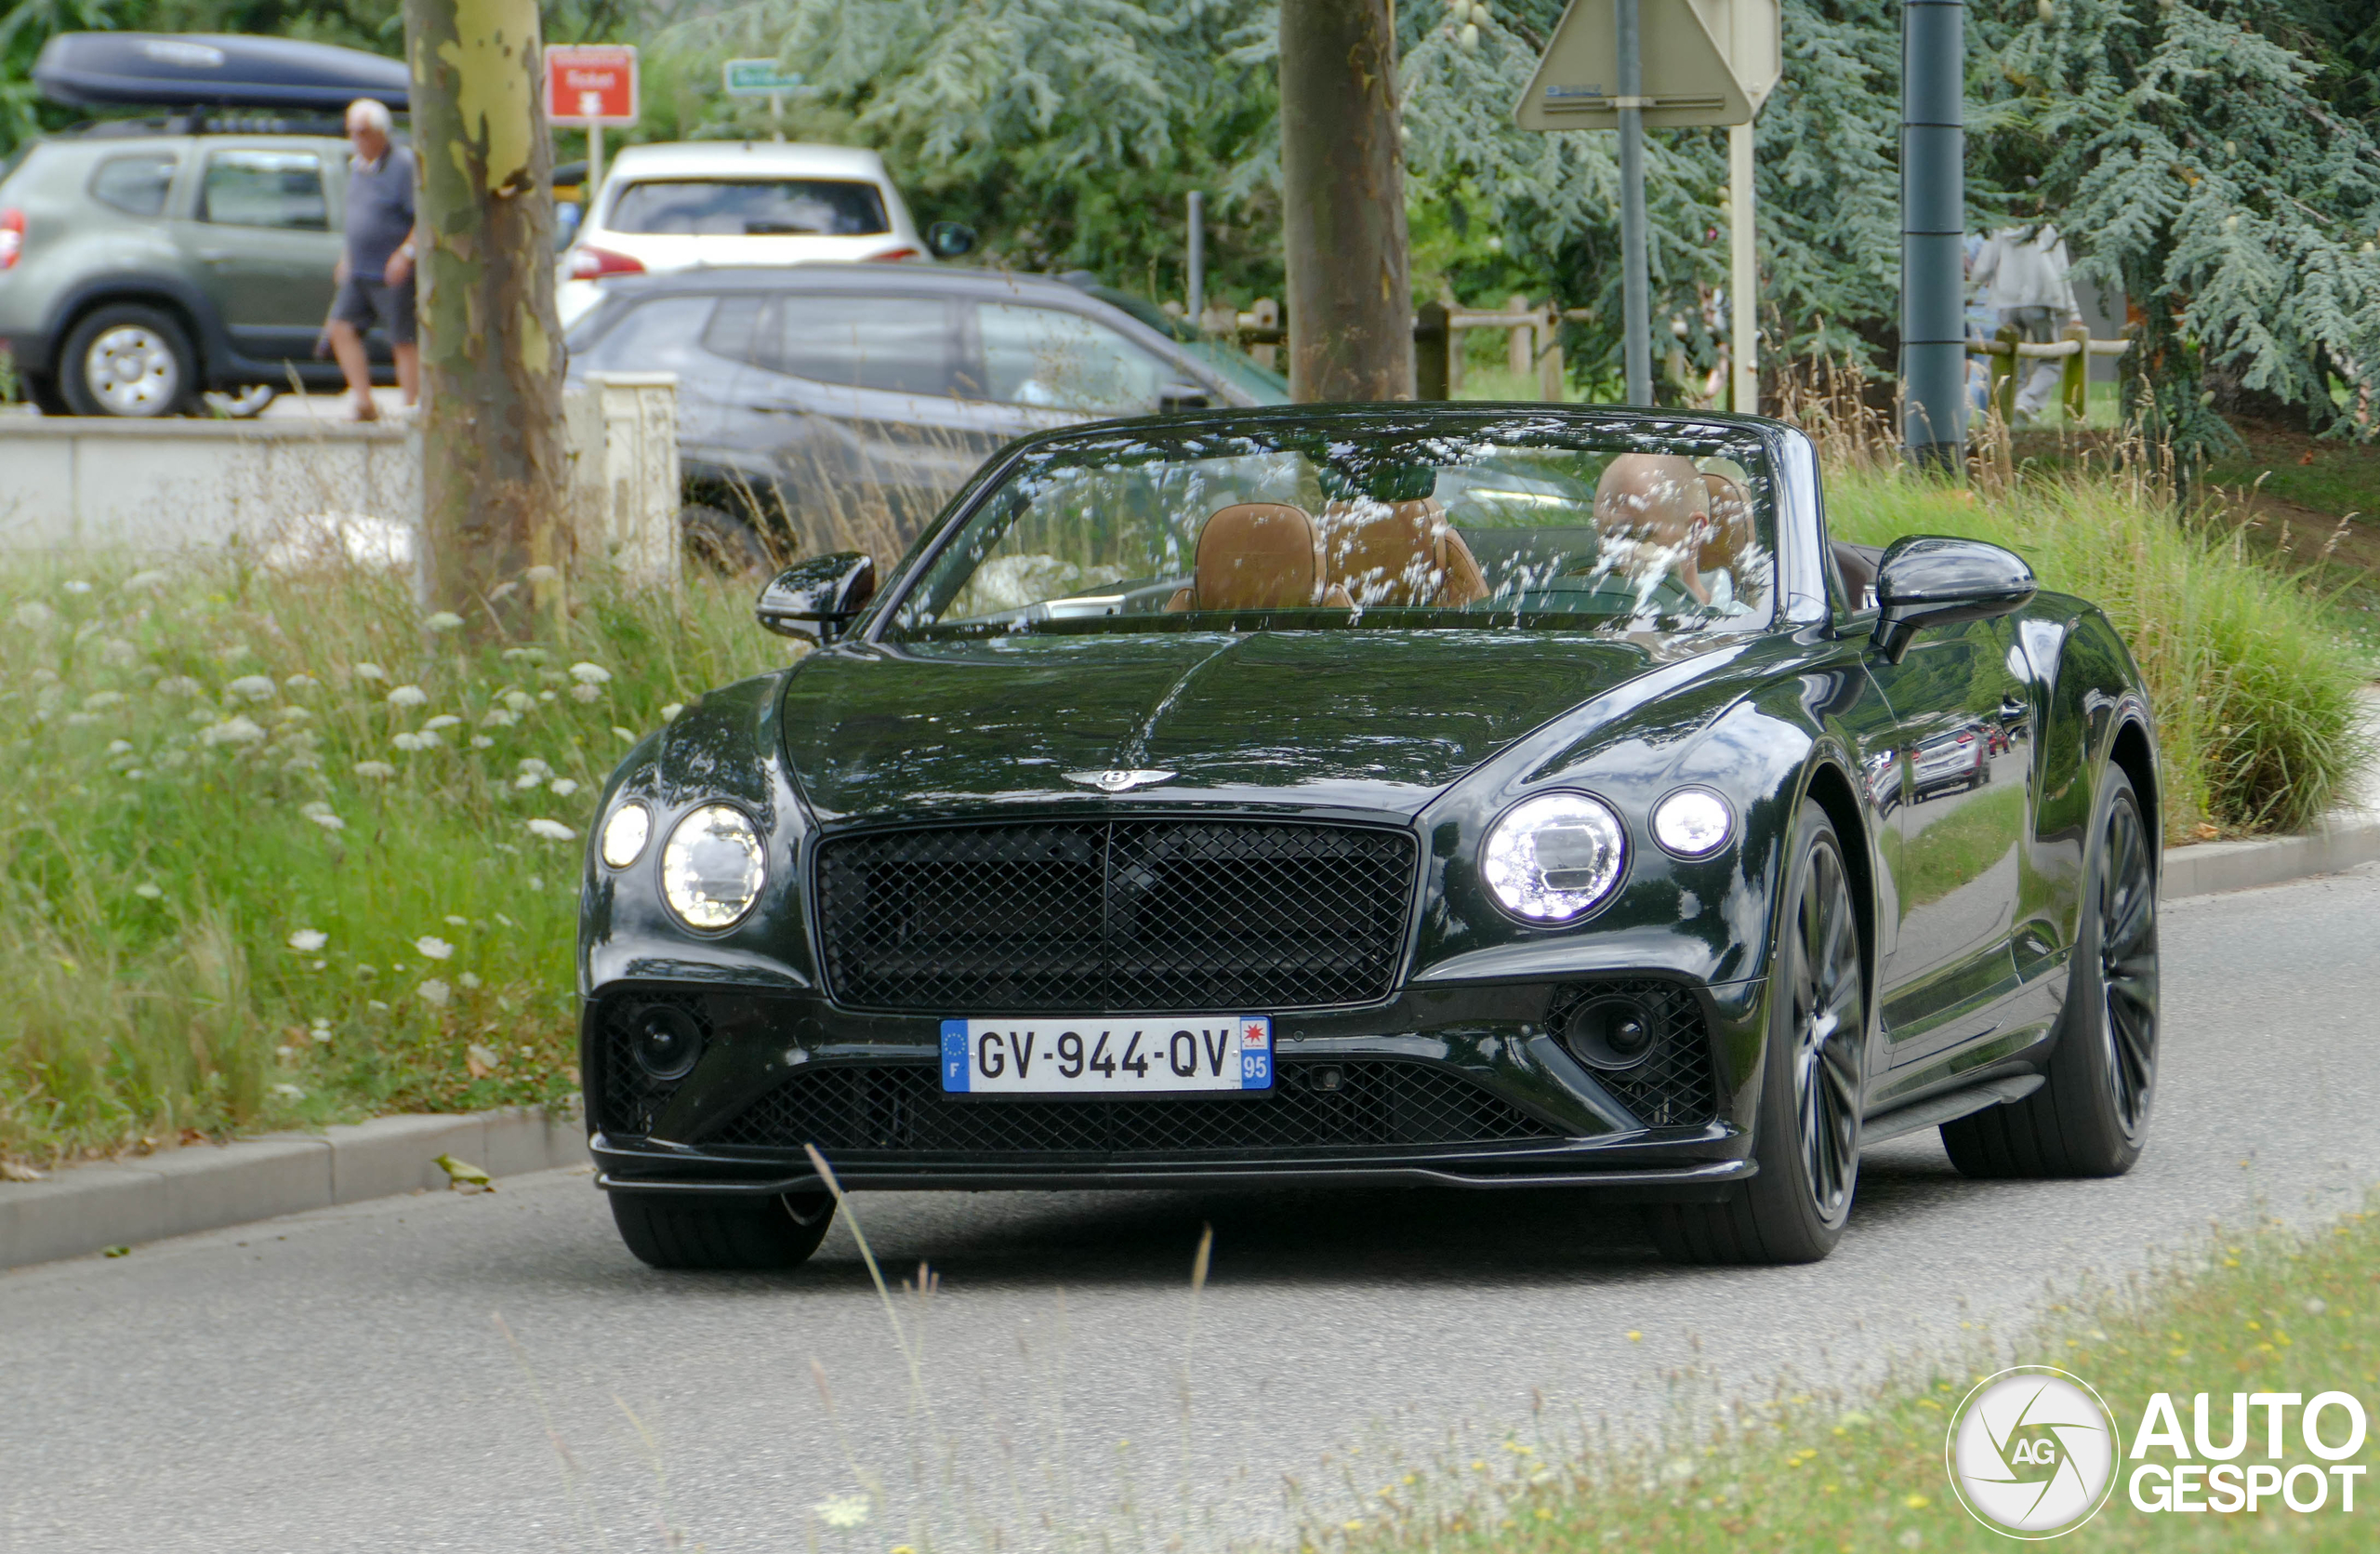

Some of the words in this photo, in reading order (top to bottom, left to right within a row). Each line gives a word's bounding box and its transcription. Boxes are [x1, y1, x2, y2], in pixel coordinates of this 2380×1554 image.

[1104, 771, 1126, 783] B
[978, 1029, 1229, 1079] GV-944-QV
[950, 1062, 960, 1078] F
[1244, 1056, 1267, 1079] 95
